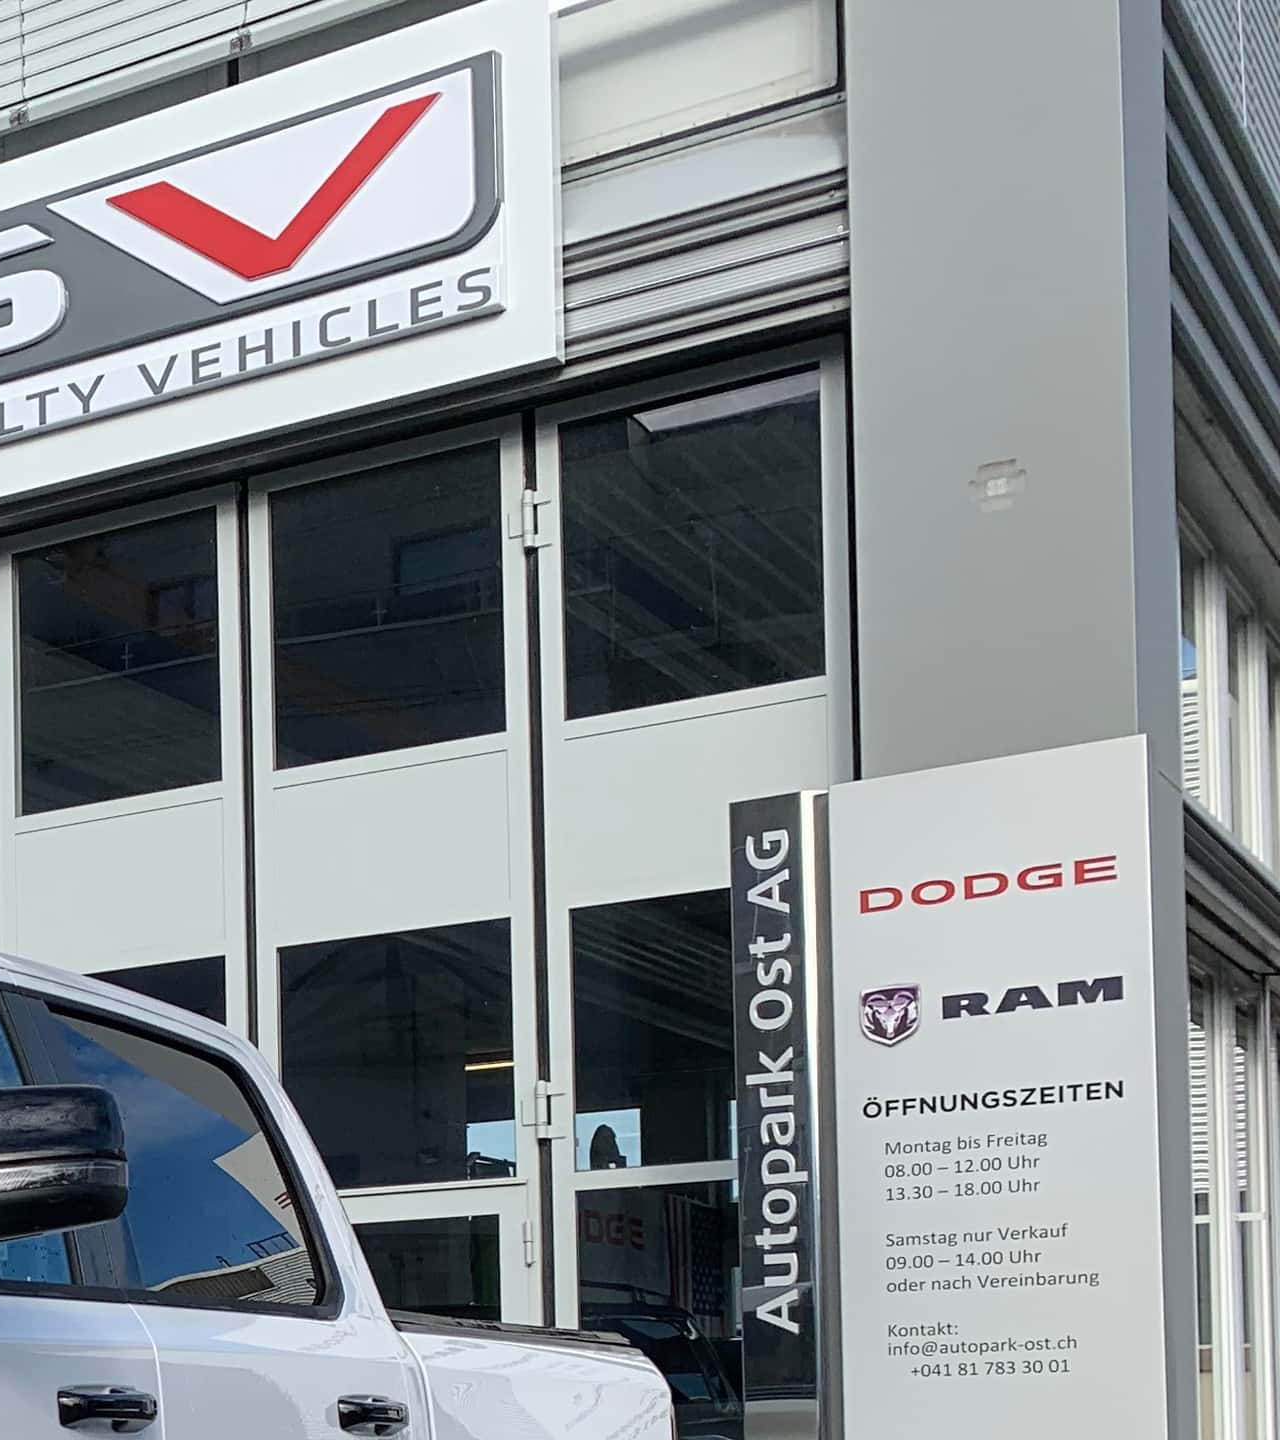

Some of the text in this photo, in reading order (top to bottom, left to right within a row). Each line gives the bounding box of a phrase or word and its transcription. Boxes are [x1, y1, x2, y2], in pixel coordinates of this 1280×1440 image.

[138, 266, 494, 397] VEHICLES
[858, 855, 1118, 914] DODGE
[941, 976, 1124, 1020] RAM
[745, 828, 808, 1334] Autopark Ost AG
[862, 1080, 1125, 1119] ÖFFNUNGSZEITEN
[885, 1132, 1048, 1155] Montag bis Freitag
[885, 1162, 933, 1178] 08.00
[954, 1157, 1002, 1174] 12.00
[1008, 1155, 1040, 1170] Uhr
[886, 1185, 933, 1201] 13.30
[954, 1180, 1002, 1197] 18.00
[1008, 1178, 1040, 1193] Uhr
[886, 1223, 1068, 1247] Samstag nur Verkauf
[886, 1255, 934, 1270] 09.00
[955, 1251, 1003, 1267] 14.00
[1009, 1249, 1042, 1264] Uhr
[886, 1272, 1099, 1292] oder nach Vereinbarung
[888, 1322, 959, 1337] Kontakt:
[888, 1336, 1078, 1356] info@autopark-ost.ch
[911, 1359, 1070, 1377] +041 81 783 30 01
